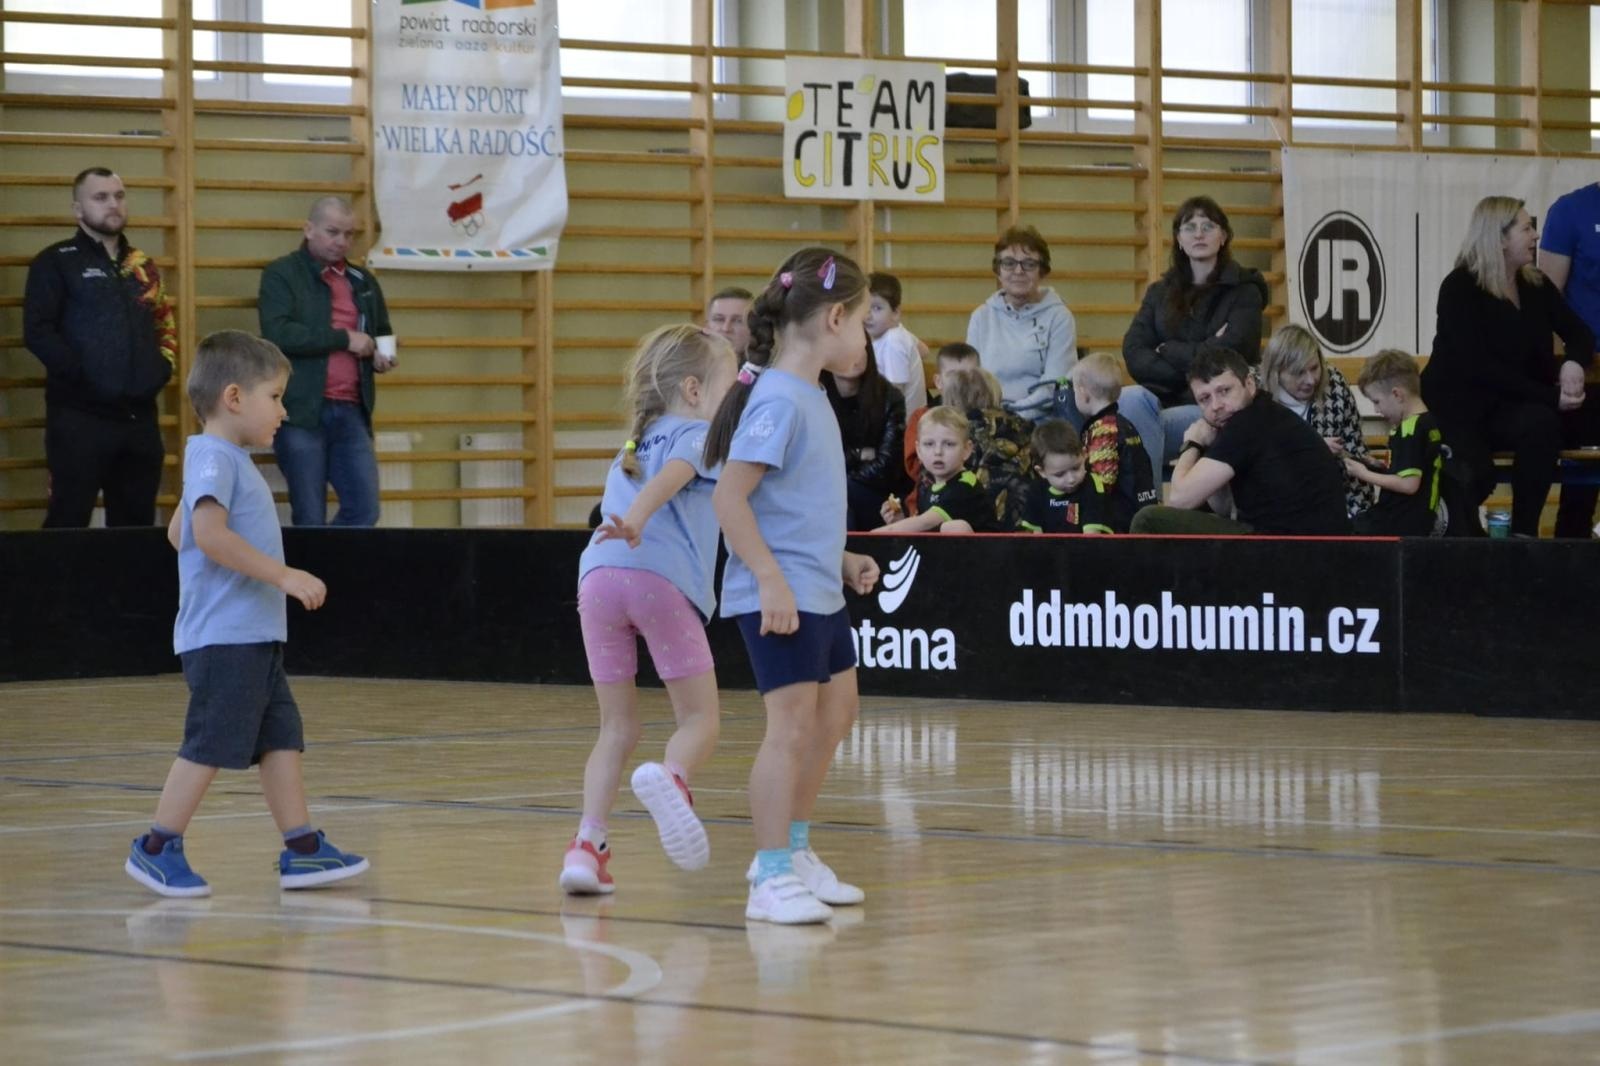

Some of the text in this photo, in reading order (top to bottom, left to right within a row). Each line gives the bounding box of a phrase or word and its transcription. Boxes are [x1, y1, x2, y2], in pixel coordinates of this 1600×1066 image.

[399, 12, 450, 34] powiat
[401, 83, 529, 114] MAŁY SPORT
[803, 79, 935, 131] TEAM
[381, 125, 556, 158] WIELKA RADOŚĆ
[793, 130, 940, 194] CITRUS
[1313, 239, 1372, 321] JR
[1008, 588, 1382, 655] ddmbohumin.cz
